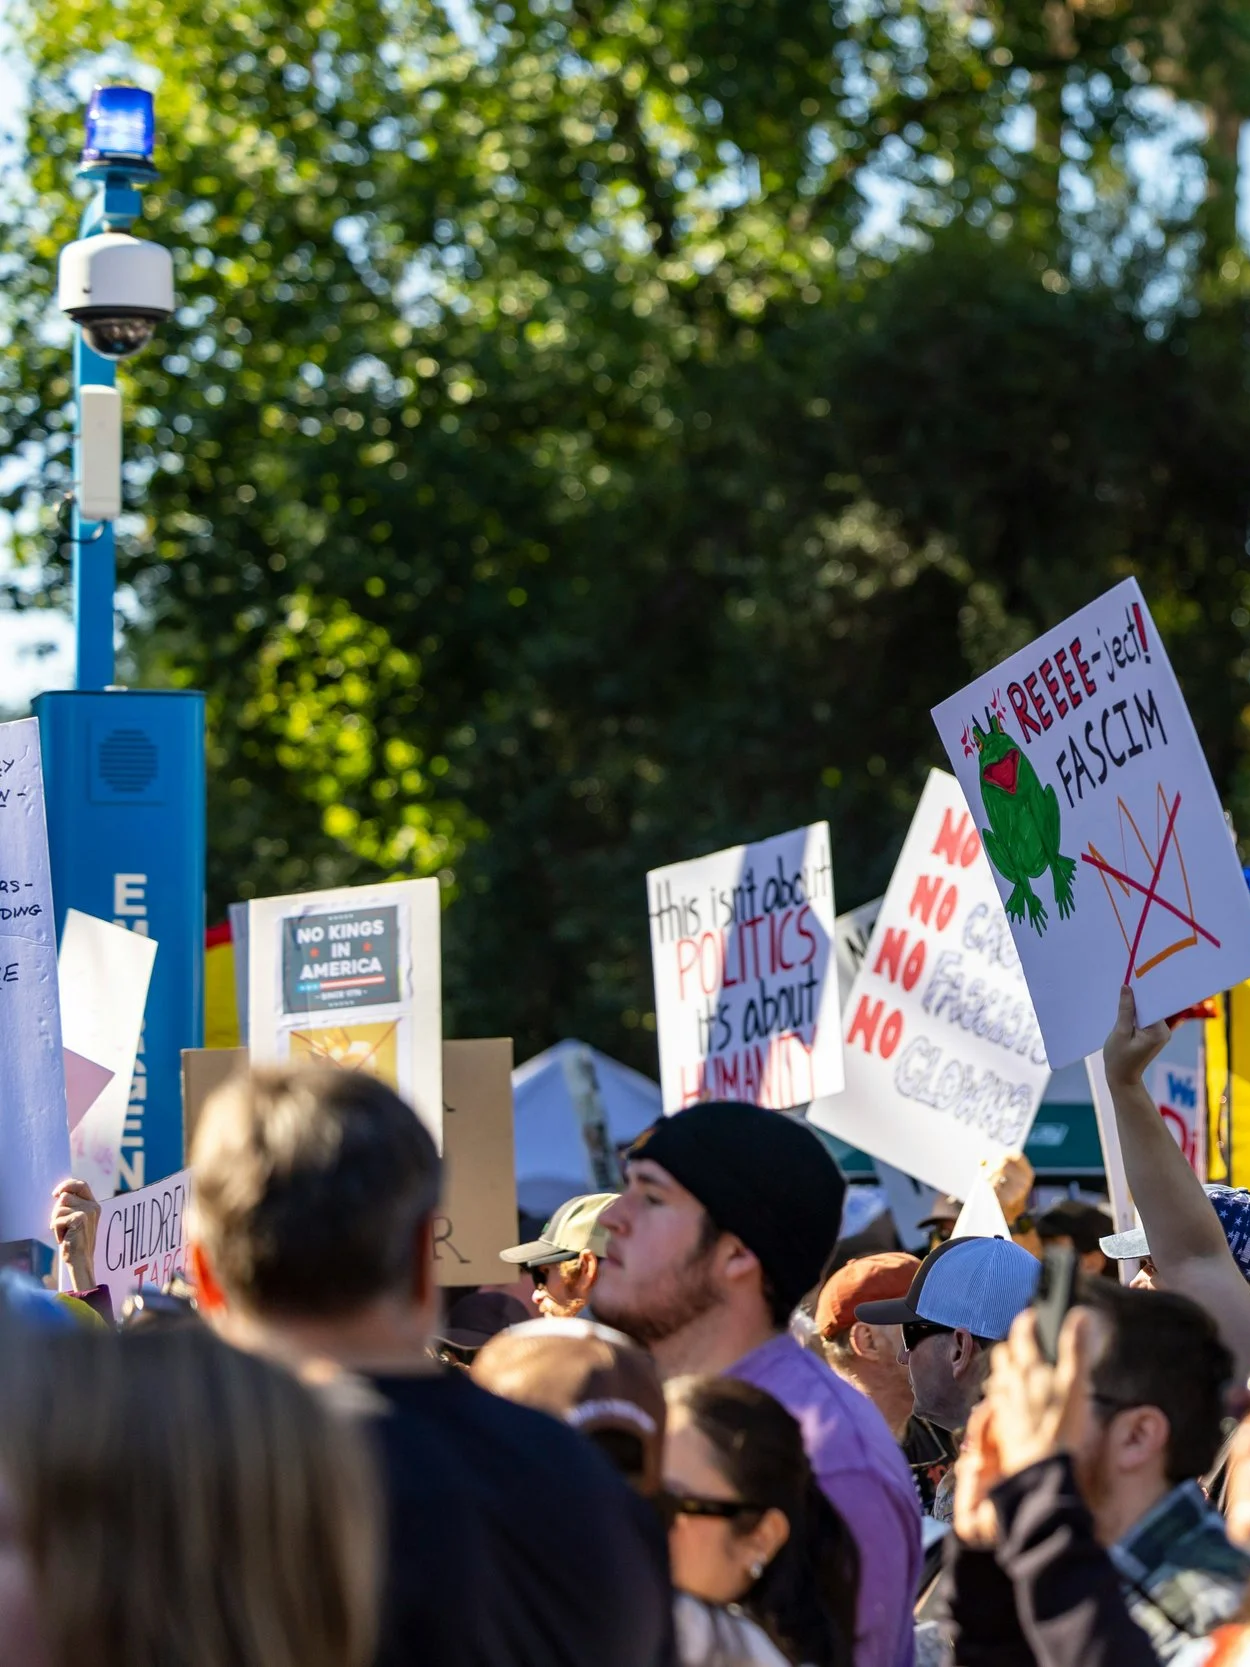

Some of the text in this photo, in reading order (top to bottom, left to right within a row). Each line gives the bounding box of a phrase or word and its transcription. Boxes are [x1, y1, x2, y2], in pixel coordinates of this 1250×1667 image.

[1006, 602, 1151, 744] REEEE-ject!
[1056, 688, 1168, 809] FASCIM
[931, 807, 982, 869] NO
[297, 919, 384, 944] NO KINGS
[649, 879, 700, 943] this
[908, 874, 958, 932] NO
[300, 957, 382, 980] AMERICA
[331, 942, 351, 957] IN
[677, 905, 817, 1000] POLITICS
[873, 928, 926, 992] NO
[743, 960, 820, 1043] about
[846, 995, 904, 1059] NO
[681, 1025, 818, 1110] HUMANITY
